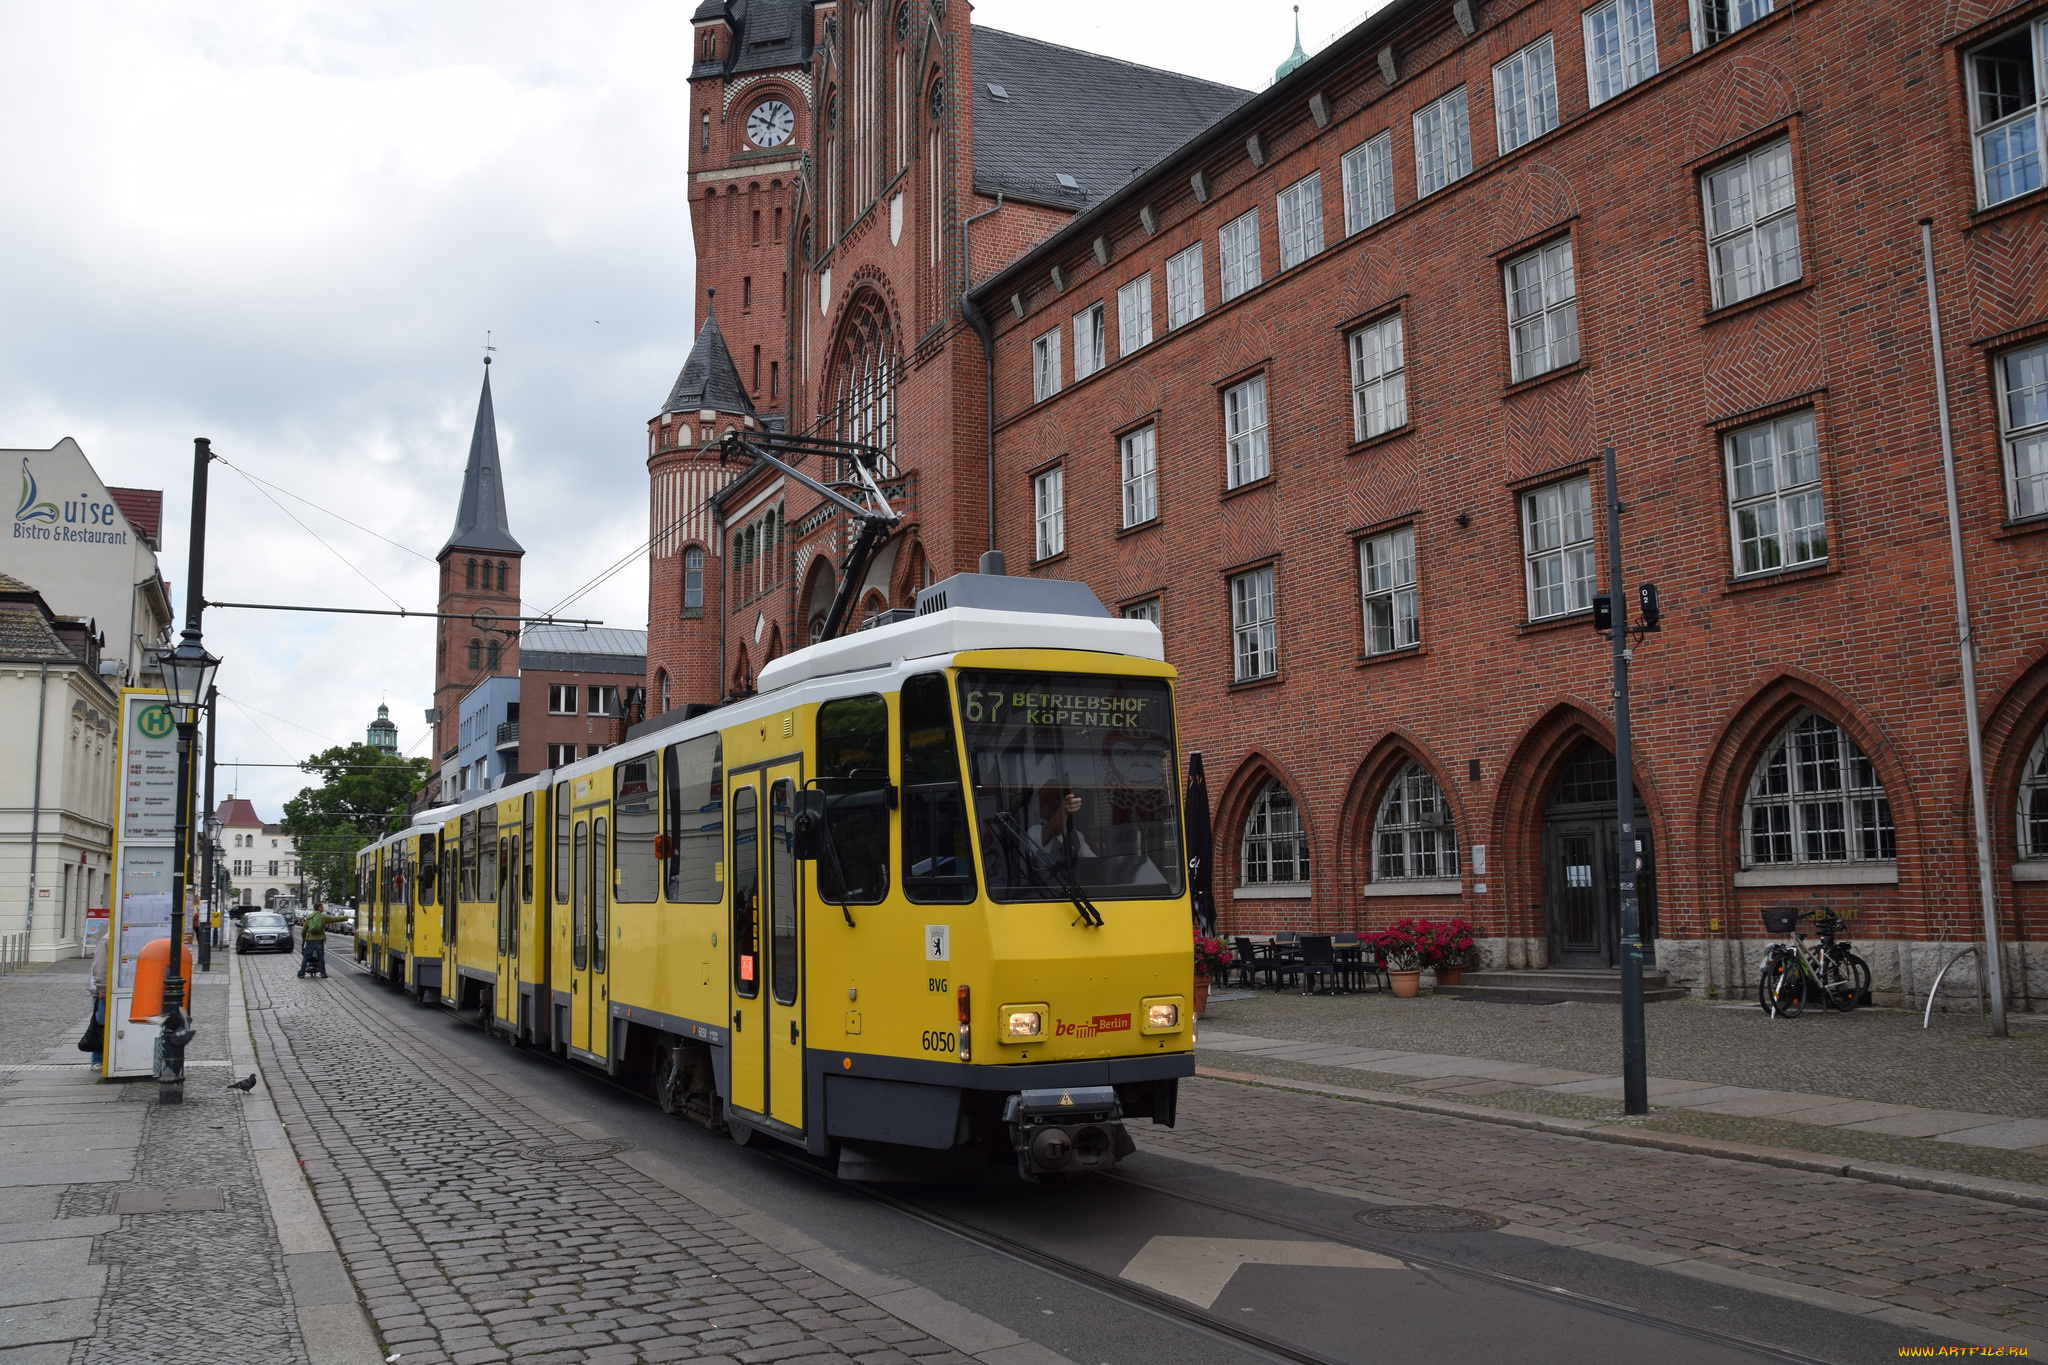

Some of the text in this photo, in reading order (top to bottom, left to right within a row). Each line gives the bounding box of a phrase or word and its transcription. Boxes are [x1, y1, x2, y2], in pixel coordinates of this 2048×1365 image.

[13, 522, 51, 540] Bistro
[63, 526, 127, 545] Restaurant
[966, 690, 1150, 723] 67 BETRIEBSHOF
[148, 713, 165, 731] H
[928, 977, 948, 993] BVG
[1055, 1018, 1128, 1037] be Berlin
[922, 1030, 955, 1053] 6050
